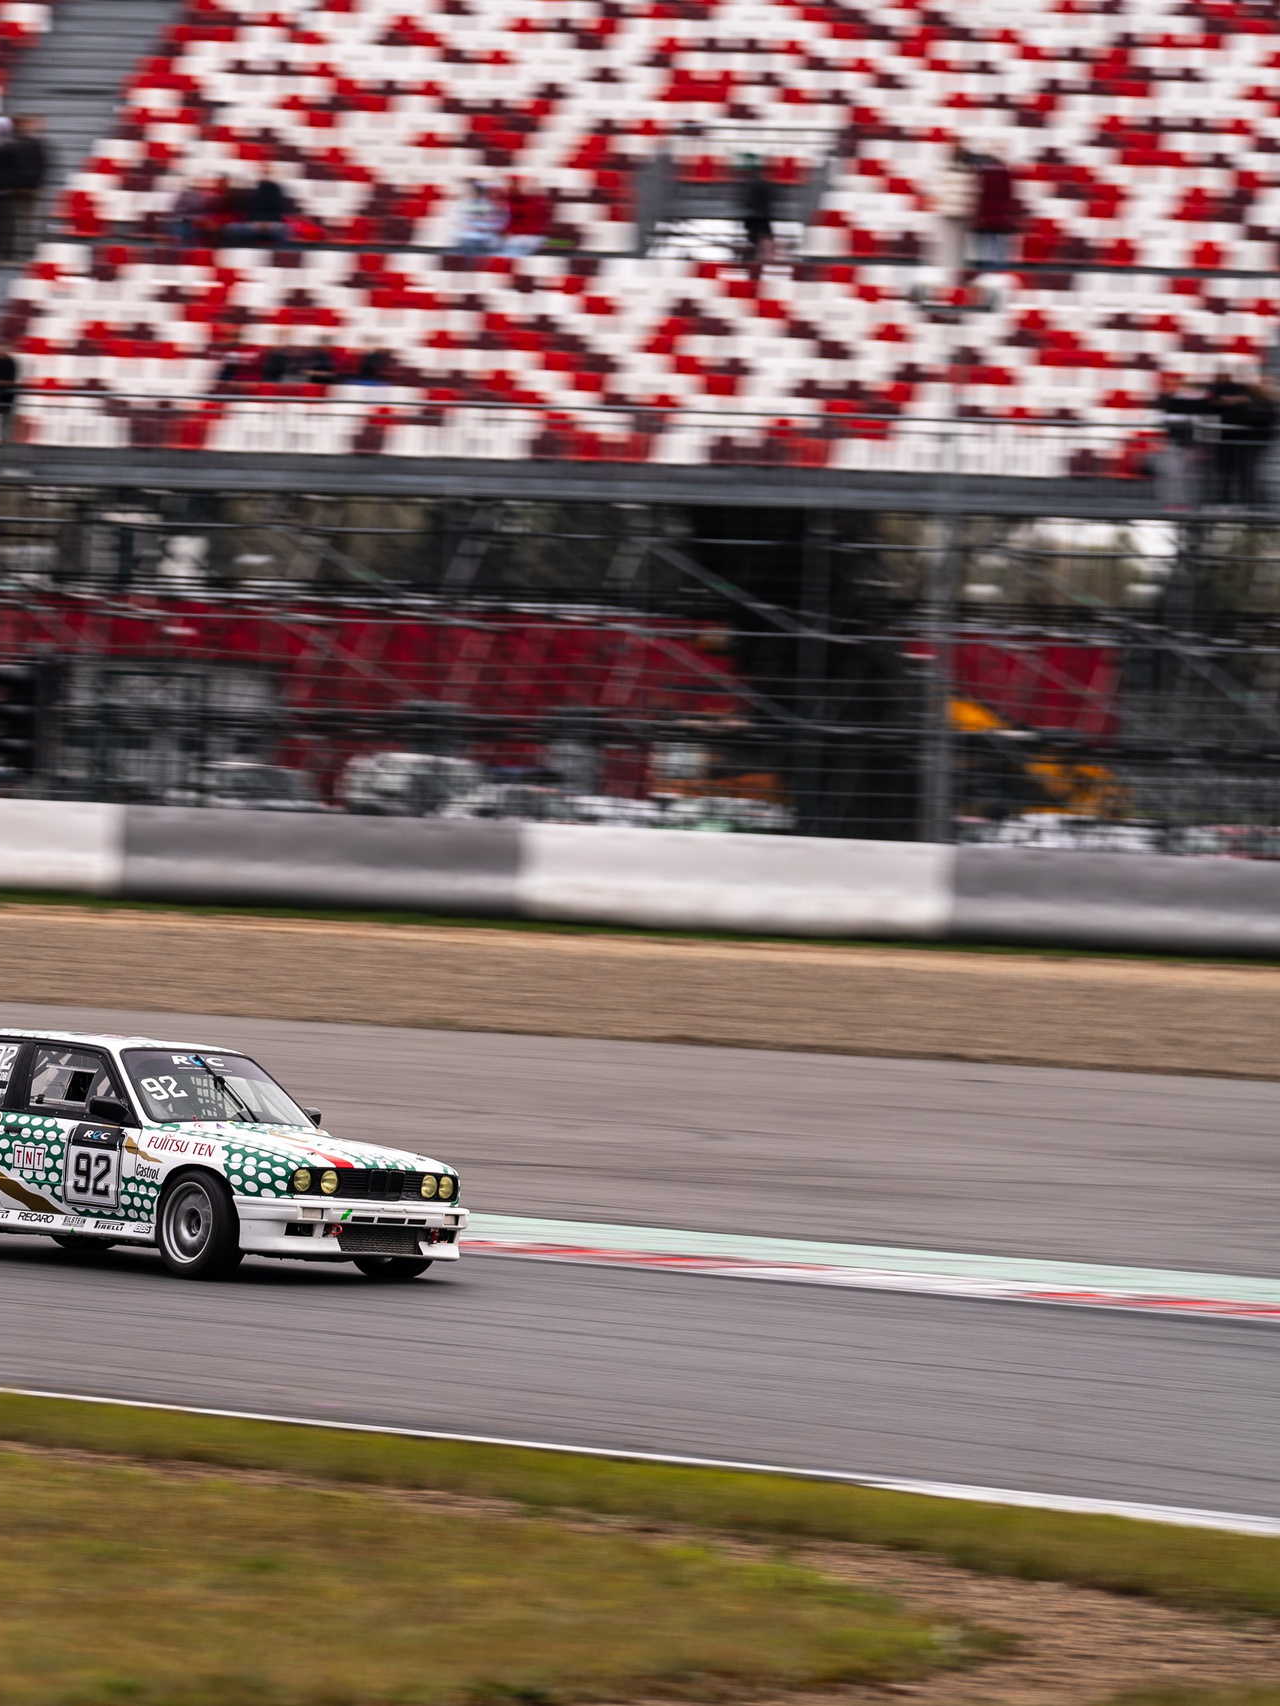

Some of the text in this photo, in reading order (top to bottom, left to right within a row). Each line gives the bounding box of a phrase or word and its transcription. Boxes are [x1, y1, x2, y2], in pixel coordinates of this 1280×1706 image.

[140, 1075, 188, 1101] 92
[147, 1135, 216, 1157] FUJITSU TEN
[16, 1150, 43, 1166] TNT
[72, 1151, 112, 1198] 92
[136, 1163, 160, 1180] Castrol
[17, 1211, 54, 1223] RECARO
[64, 1216, 88, 1225] BILSTEIN
[94, 1220, 125, 1231] PIRELLI
[133, 1223, 153, 1234] BBS
